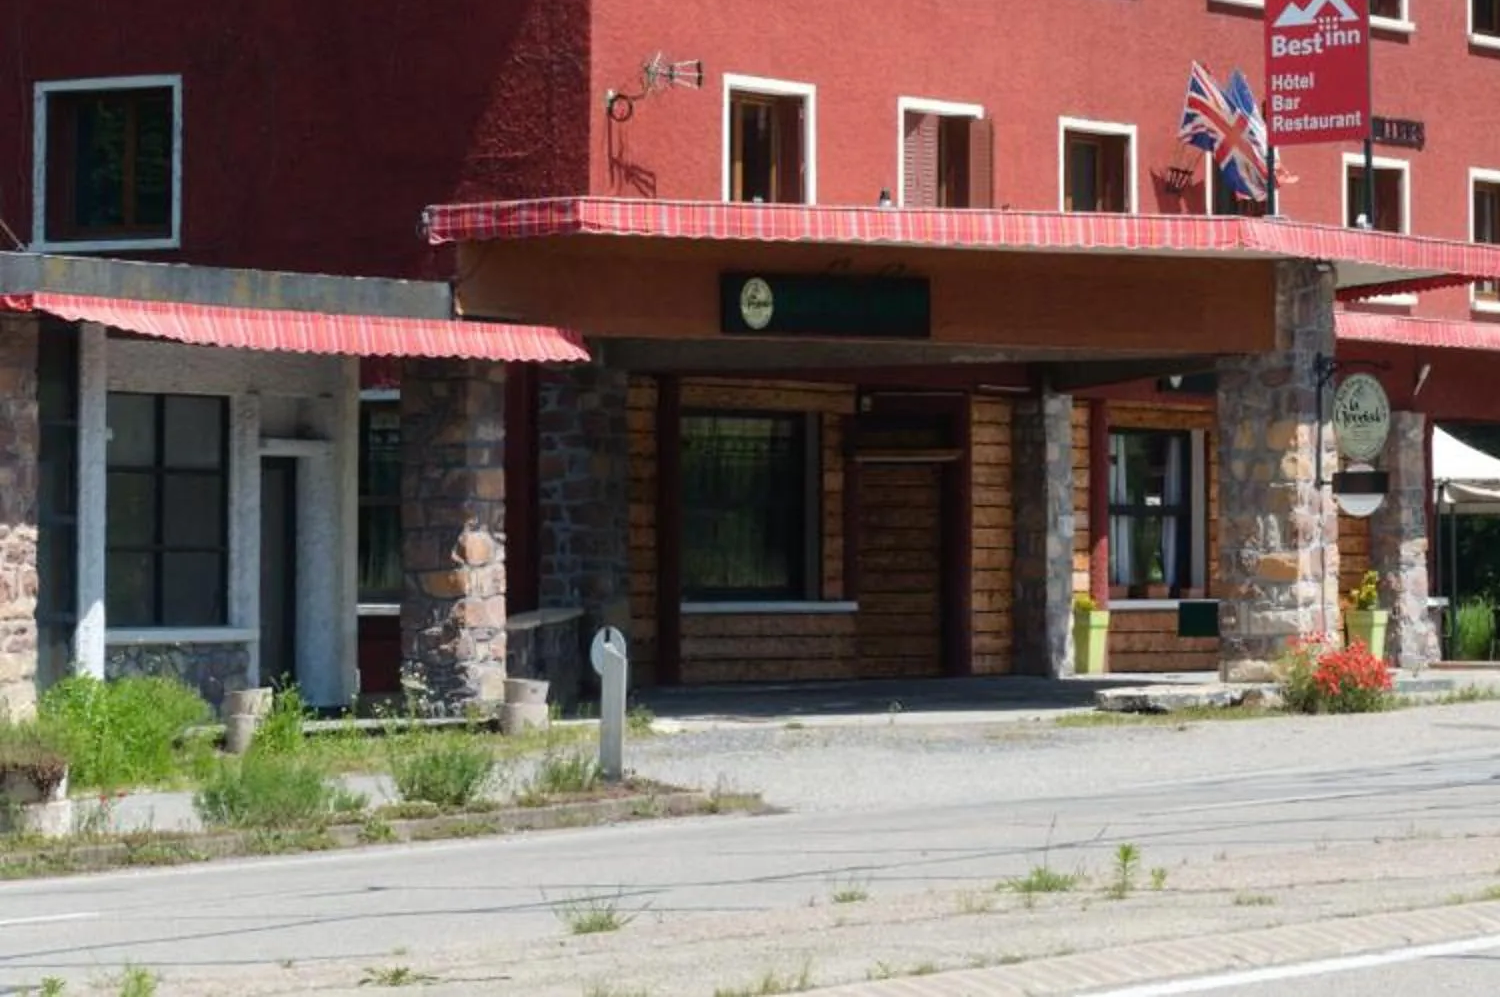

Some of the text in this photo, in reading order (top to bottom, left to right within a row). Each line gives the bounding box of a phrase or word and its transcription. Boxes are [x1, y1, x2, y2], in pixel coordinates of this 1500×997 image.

[1271, 34, 1323, 58] Best
[1271, 72, 1315, 91] Hôtel
[1271, 93, 1301, 112] Bar
[1272, 110, 1362, 133] Restaurant
